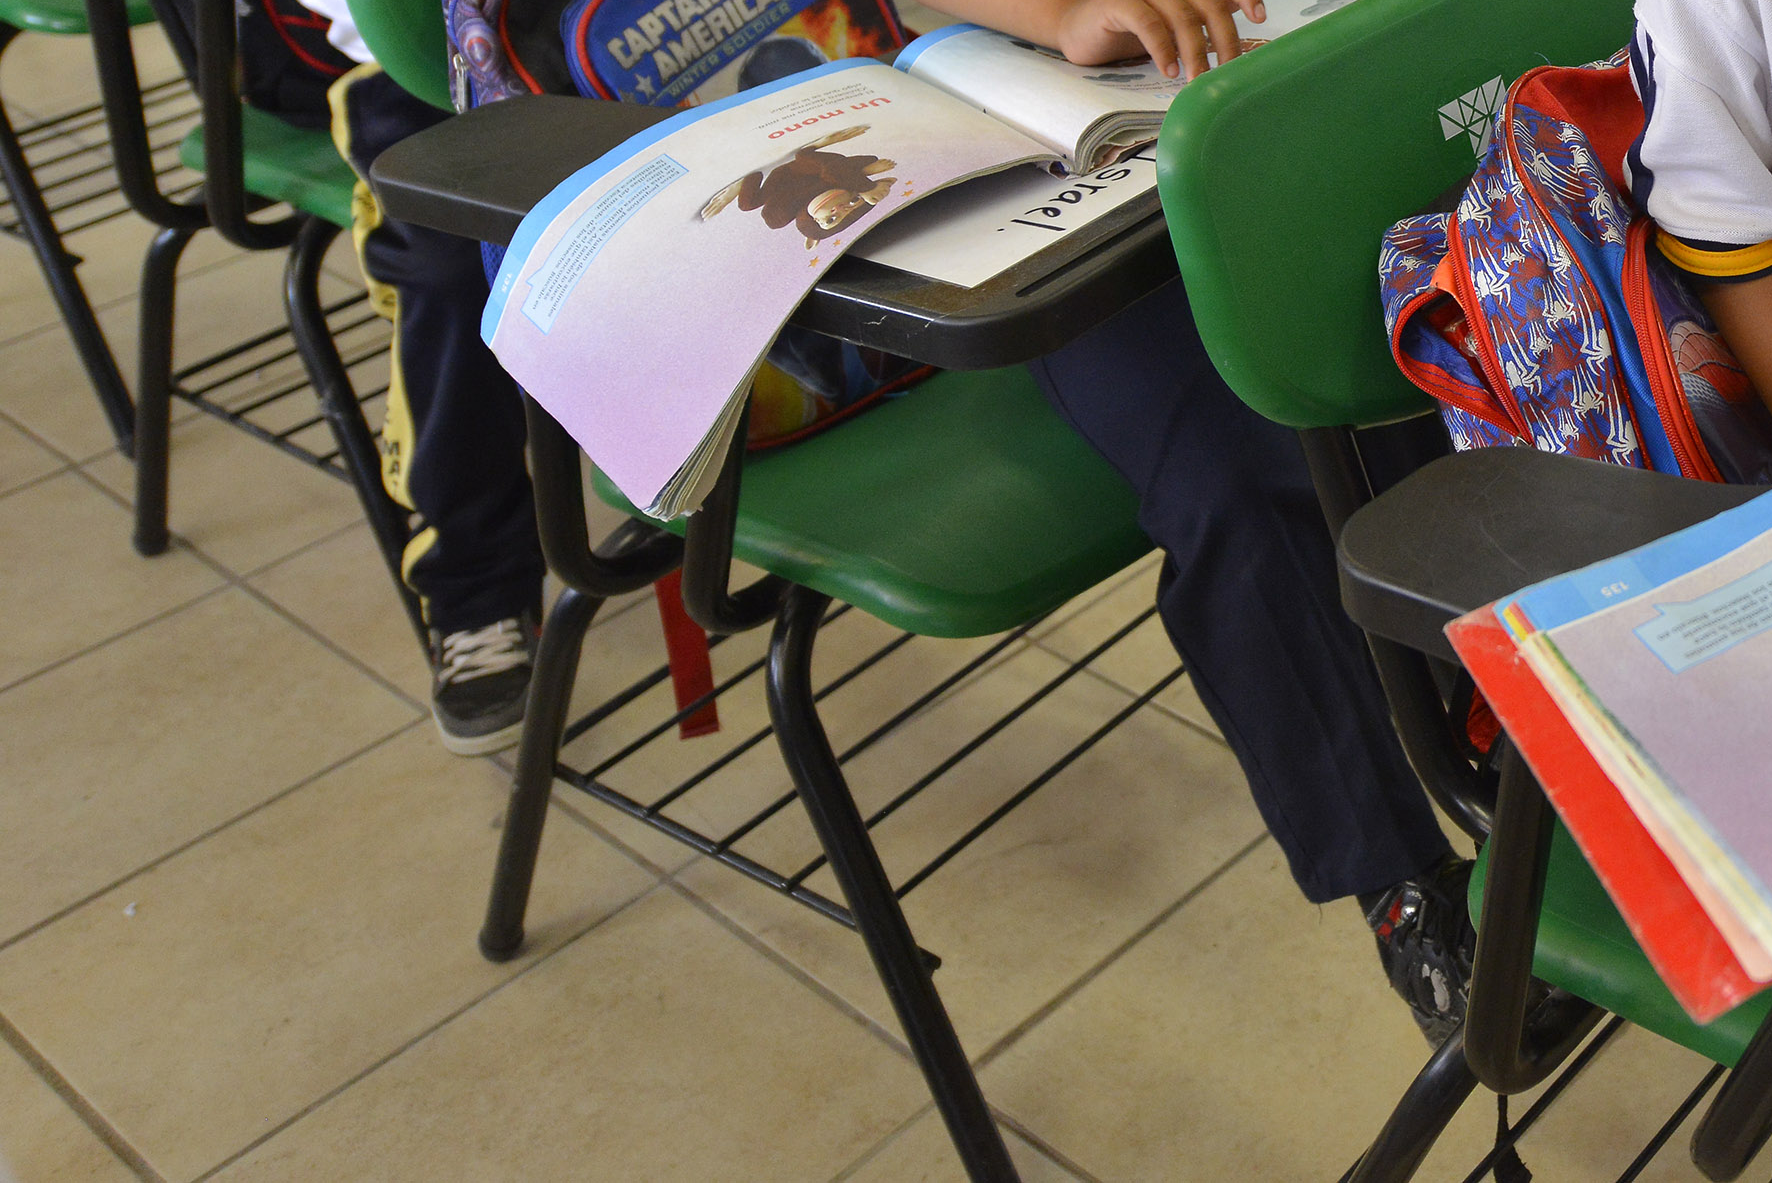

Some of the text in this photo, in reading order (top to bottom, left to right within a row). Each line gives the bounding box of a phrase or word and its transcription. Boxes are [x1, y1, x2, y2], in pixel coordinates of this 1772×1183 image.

[666, 0, 792, 97] WINTER SOLDIER
[767, 97, 891, 140] Un mono
[593, 197, 618, 220] mundo
[623, 183, 649, 208] manera
[625, 182, 659, 213] pequeños
[599, 211, 627, 237] poemas
[564, 244, 589, 275] también
[580, 236, 603, 262] hablan
[542, 257, 571, 300] encontrarás
[548, 283, 562, 301] hace
[546, 283, 569, 317] animales
[1600, 580, 1628, 597] 135
